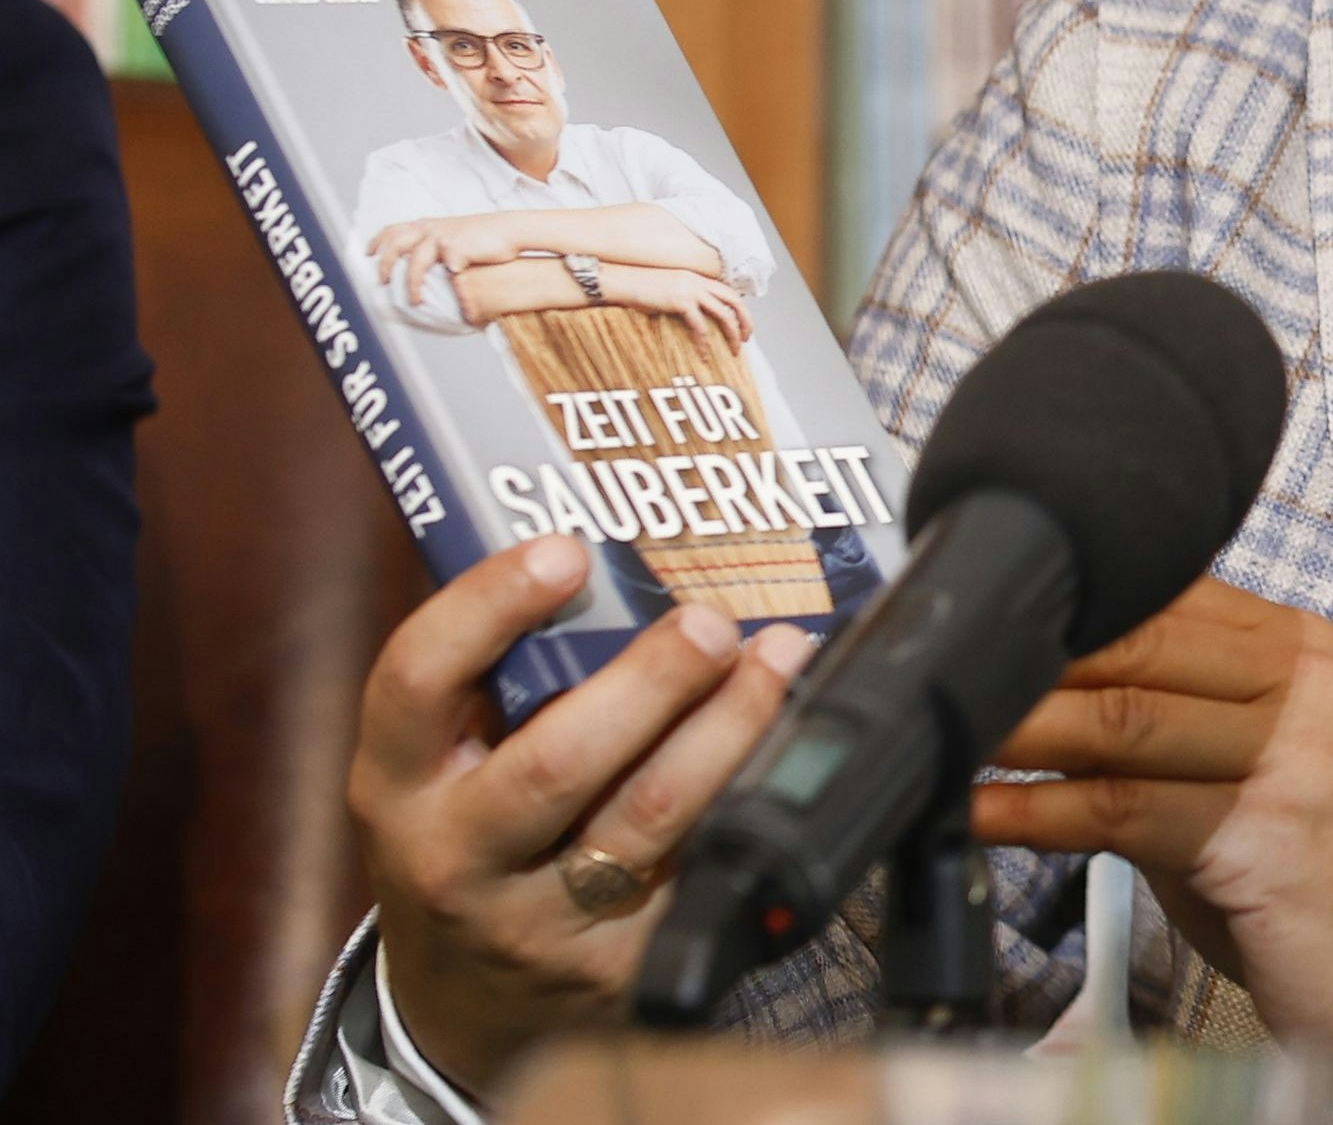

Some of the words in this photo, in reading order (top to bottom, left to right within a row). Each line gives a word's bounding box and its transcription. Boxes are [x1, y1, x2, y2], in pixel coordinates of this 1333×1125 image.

[225, 140, 359, 369] SAUBERKEIT
[342, 360, 401, 450] FÜR
[545, 388, 656, 452] ZEIT
[648, 376, 761, 444] FÜR
[381, 445, 447, 539] ZEIT
[487, 445, 894, 544] SAUBERKEIT
